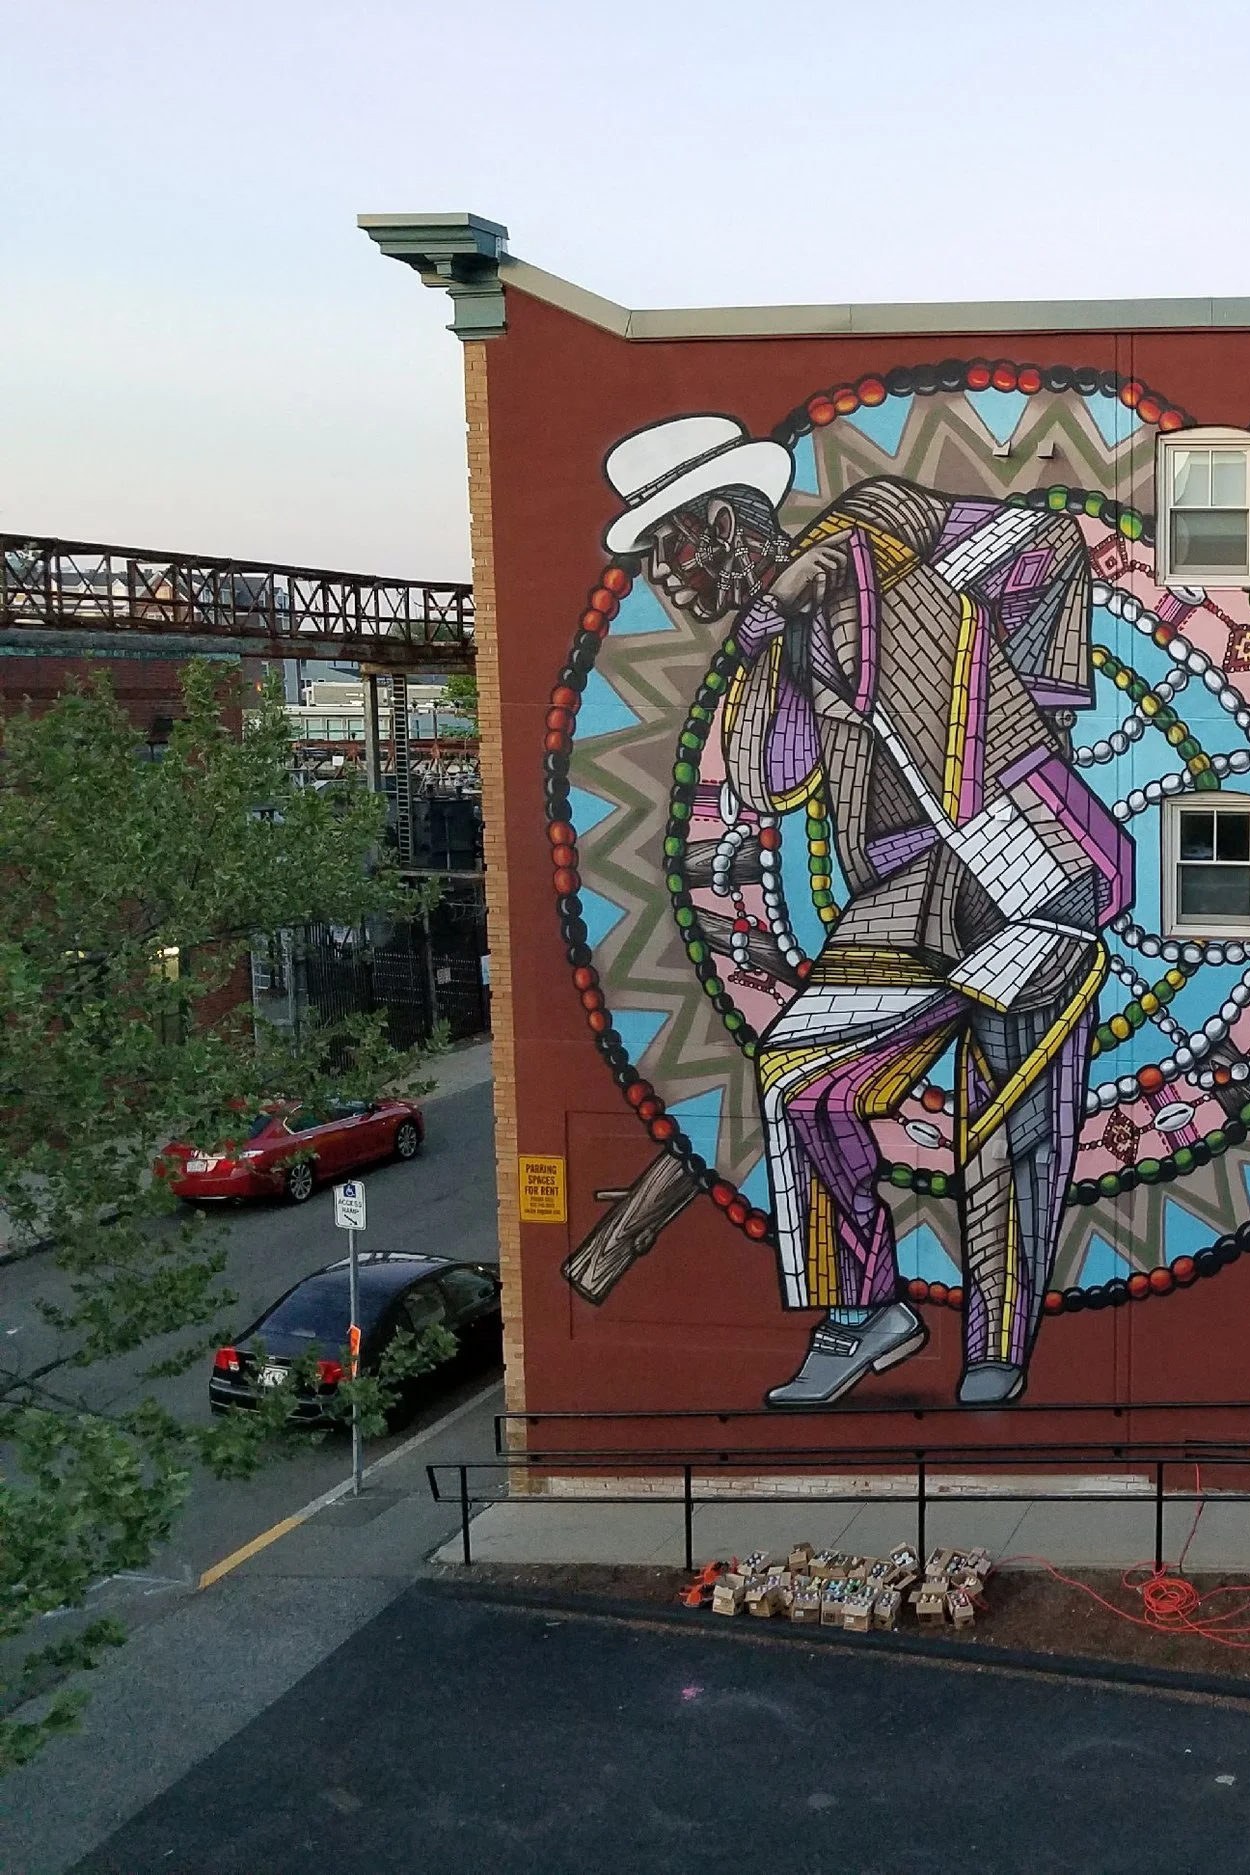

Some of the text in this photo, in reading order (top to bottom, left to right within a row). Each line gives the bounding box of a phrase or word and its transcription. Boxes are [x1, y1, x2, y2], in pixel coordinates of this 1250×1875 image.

[525, 1163, 557, 1175] PARKING
[528, 1174, 555, 1186] SPACES
[524, 1185, 559, 1197] FOR RENT
[338, 1199, 362, 1208] ACCESS
